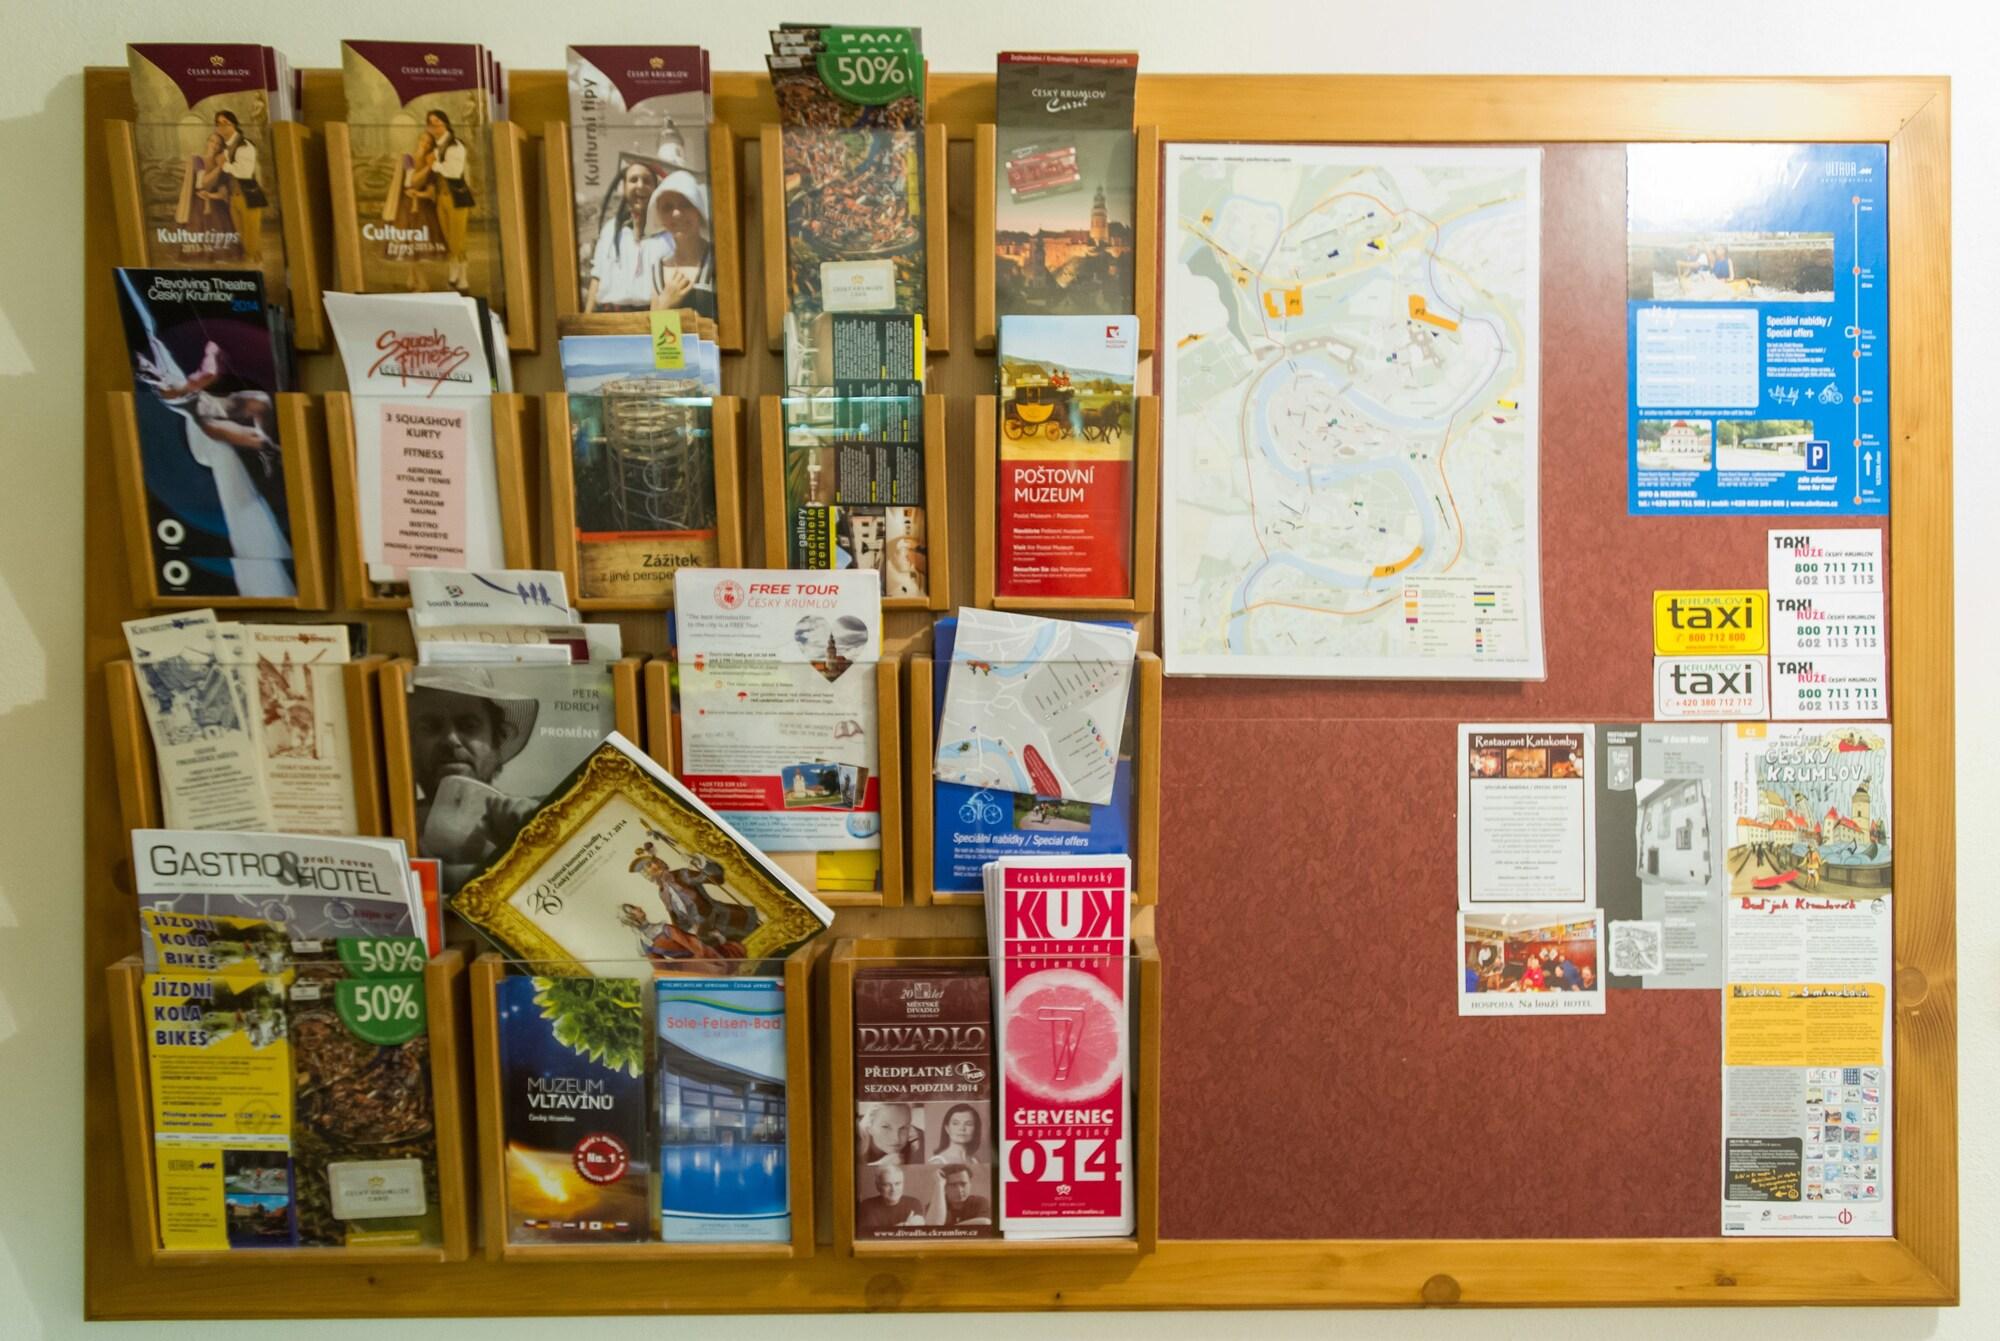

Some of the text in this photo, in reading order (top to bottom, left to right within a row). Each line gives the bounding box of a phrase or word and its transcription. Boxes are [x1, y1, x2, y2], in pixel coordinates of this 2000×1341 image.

[837, 56, 904, 85] 50%
[1032, 88, 1106, 99] ČESKÝ KRUMLOV
[581, 79, 600, 186] Kulturní tipy
[157, 228, 241, 249] Kulturtipps
[362, 223, 429, 242] Cultural
[154, 277, 256, 291] Revolving Theatre
[186, 290, 233, 302] Krumlov
[1767, 315, 1832, 327] Speciální nabídky /
[1767, 328, 1814, 339] Special offers
[386, 413, 462, 428] 3 SQUASHOVÉ
[406, 428, 441, 439] KURTY
[404, 448, 444, 459] FITNESS
[1812, 446, 1823, 466] P
[1014, 465, 1095, 484] POŠTOVNÍ
[1014, 488, 1084, 502] MUZEUM
[403, 498, 444, 507] SOLARIUM
[411, 507, 437, 516] SAUNA
[409, 521, 438, 529] BISTRO
[797, 507, 808, 548] gallery
[818, 509, 826, 567] centrum
[1774, 536, 1810, 548] TAXI
[1795, 546, 1824, 557] RŮŽE
[642, 554, 700, 568] Zážitek
[1795, 563, 1874, 572] 800 711 711
[601, 570, 676, 584] z jiné perspe
[1795, 575, 1874, 585] 602 113 113
[749, 584, 839, 595] FREE TOUR
[454, 600, 489, 608] Bohemia
[784, 599, 838, 609] KRUMLOV
[1777, 599, 1812, 611] TAXI
[1667, 597, 1752, 629] taxi
[1797, 608, 1825, 620] RŮŽE
[1797, 626, 1876, 635] 800 711 711
[1797, 638, 1877, 648] 602 113 113
[1777, 662, 1813, 674] TAXI
[1670, 664, 1752, 694] taxi
[1798, 671, 1826, 683] RŮŽE
[572, 689, 599, 699] PETR
[1798, 688, 1878, 698] 800 711 711
[554, 701, 599, 712] FIDRICH
[1799, 701, 1878, 710] 602 113 113
[540, 726, 599, 739] PROMĚNY
[1475, 733, 1578, 750] Restaurant Katakomby
[1766, 742, 1832, 764] ČESKÝ
[1767, 765, 1863, 783] KRUMLOV
[953, 832, 991, 844] Speciální
[992, 832, 1024, 846] nabídky
[1033, 835, 1064, 846] Special
[1064, 836, 1089, 846] offers
[1017, 872, 1112, 883] českokrumlovský
[153, 914, 216, 931] JÍZDNÍ
[159, 932, 209, 948] KOLA
[1017, 943, 1110, 953] kulturní
[165, 952, 217, 970] BIKES
[357, 940, 424, 974] 50%
[152, 977, 213, 999] JÍZDNÍ
[900, 989, 913, 999] 20
[354, 984, 419, 1022] 50%
[1471, 1001, 1514, 1009] HOSPODA
[1519, 1000, 1532, 1008] Na
[1564, 1000, 1592, 1008] HOTEL
[154, 1006, 202, 1022] KOLA
[667, 1016, 781, 1030] Sole-Felsen-Bad
[156, 1030, 208, 1047] BIKES
[858, 1027, 986, 1051] DIVADLO
[865, 1065, 953, 1078] PŘEDPLATNÉ
[528, 1077, 603, 1093] MUZEUM
[864, 1084, 978, 1093] SEZONA PODZIM 2014
[528, 1092, 614, 1110] VLTAVÍNŮ
[1013, 1108, 1114, 1125] ČERVENEC
[1017, 1126, 1111, 1139] neprodejné
[608, 1153, 616, 1163] 1
